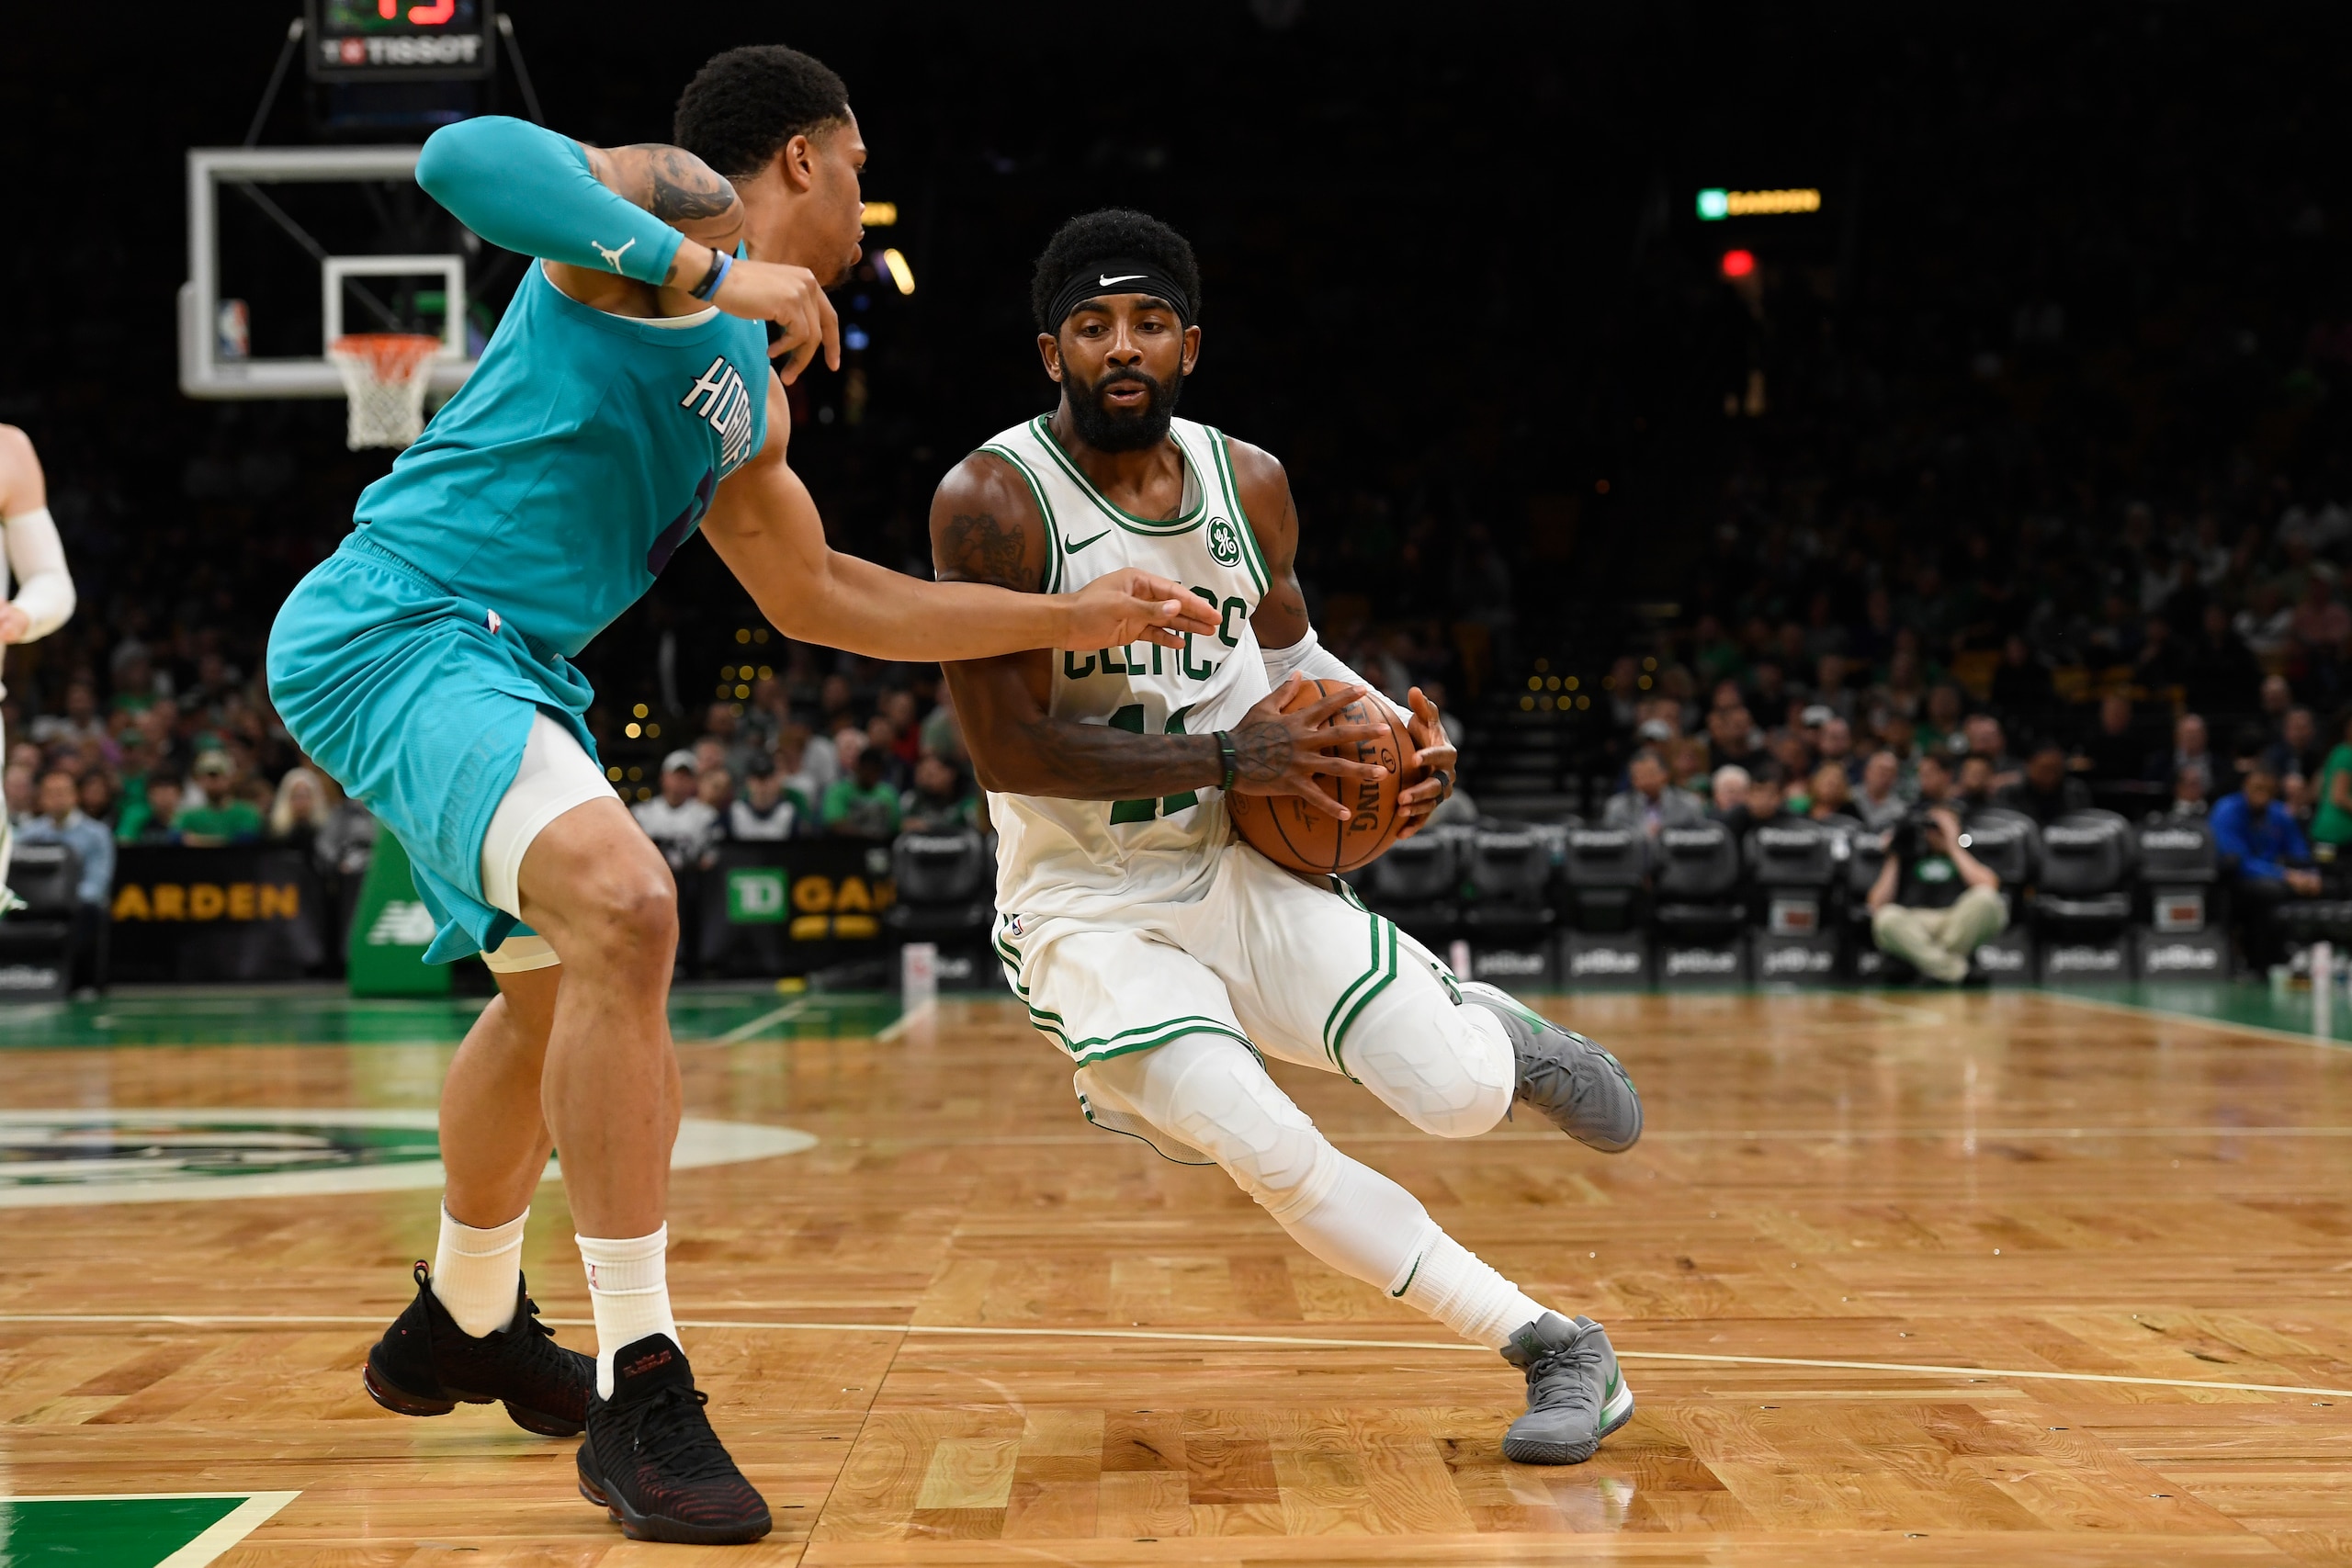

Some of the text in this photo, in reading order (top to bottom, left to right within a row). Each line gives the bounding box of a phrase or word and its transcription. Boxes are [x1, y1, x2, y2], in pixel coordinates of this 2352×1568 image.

[368, 36, 481, 64] TISSOT
[679, 355, 752, 480] HORN
[111, 882, 300, 920] ARDEN
